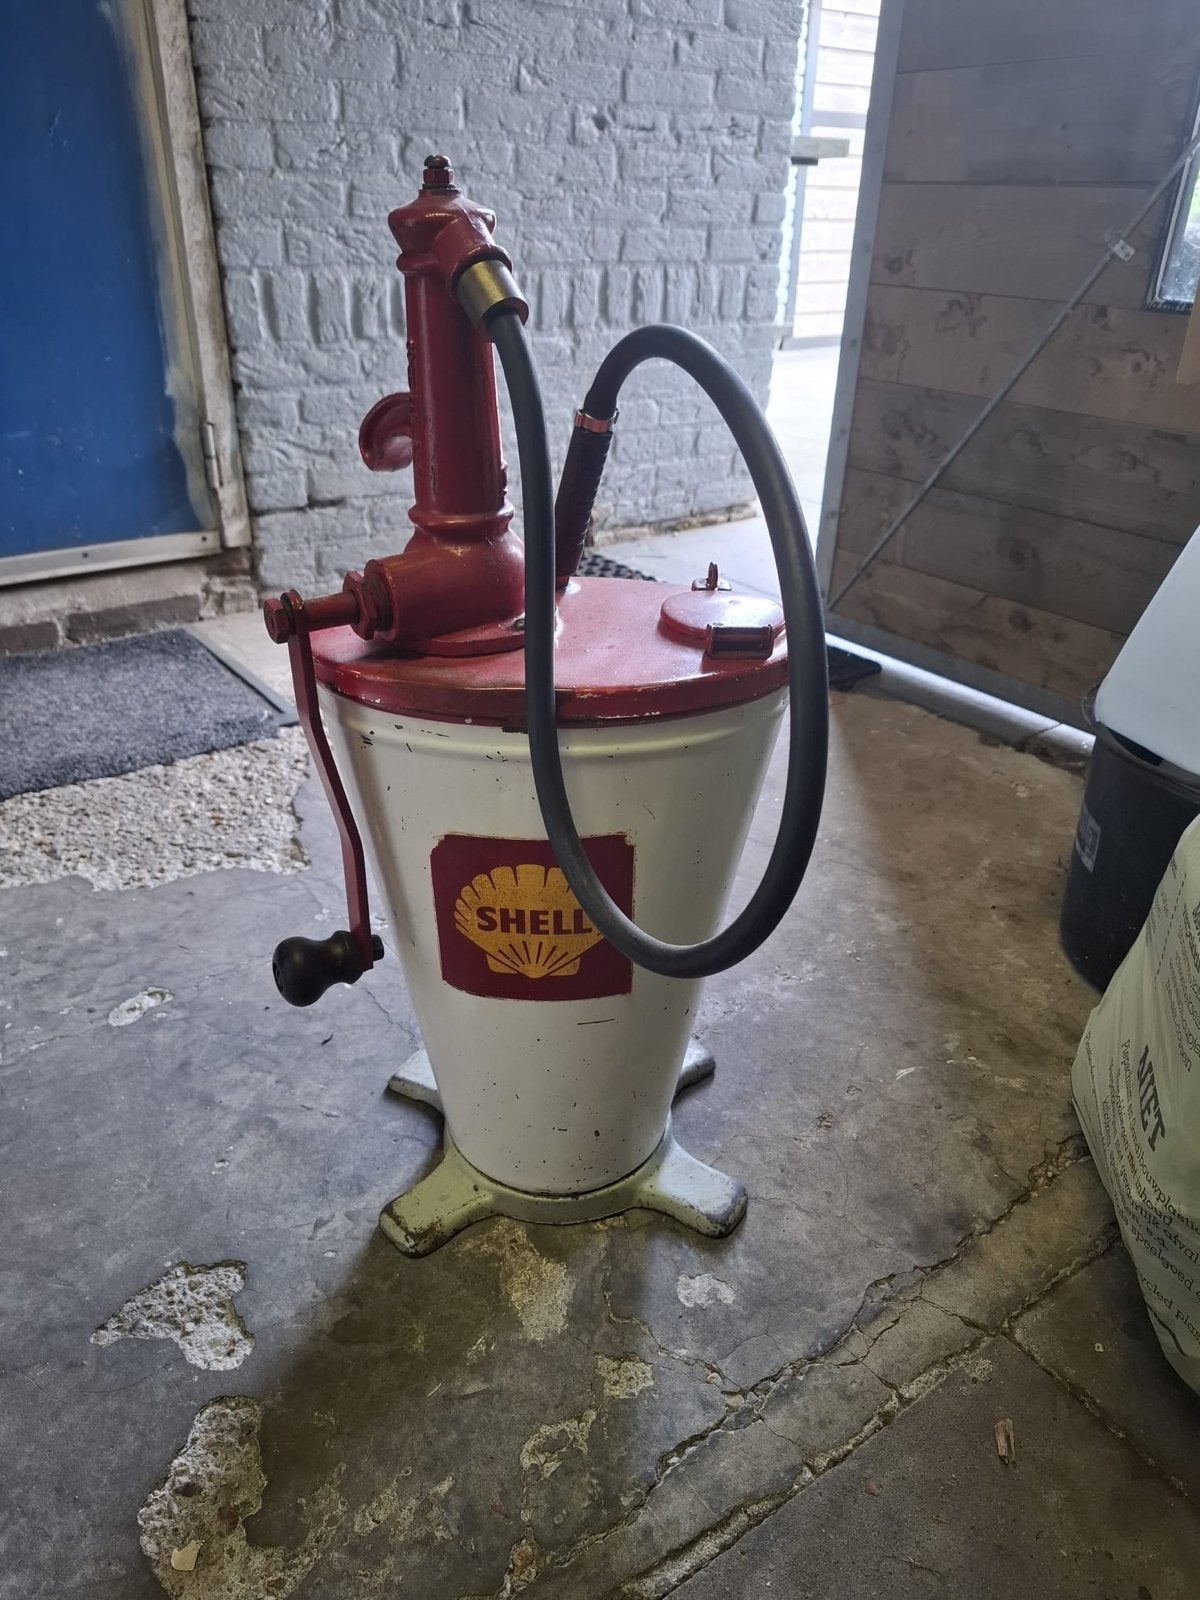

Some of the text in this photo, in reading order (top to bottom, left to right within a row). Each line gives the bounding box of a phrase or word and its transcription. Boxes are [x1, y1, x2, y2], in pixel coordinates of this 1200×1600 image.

[476, 906, 593, 935] SHELL
[1138, 1044, 1166, 1152] NIET
[1135, 1176, 1174, 1227] inhoud
[1131, 1226, 1194, 1291] speelgoed
[1163, 1228, 1199, 1265] afval
